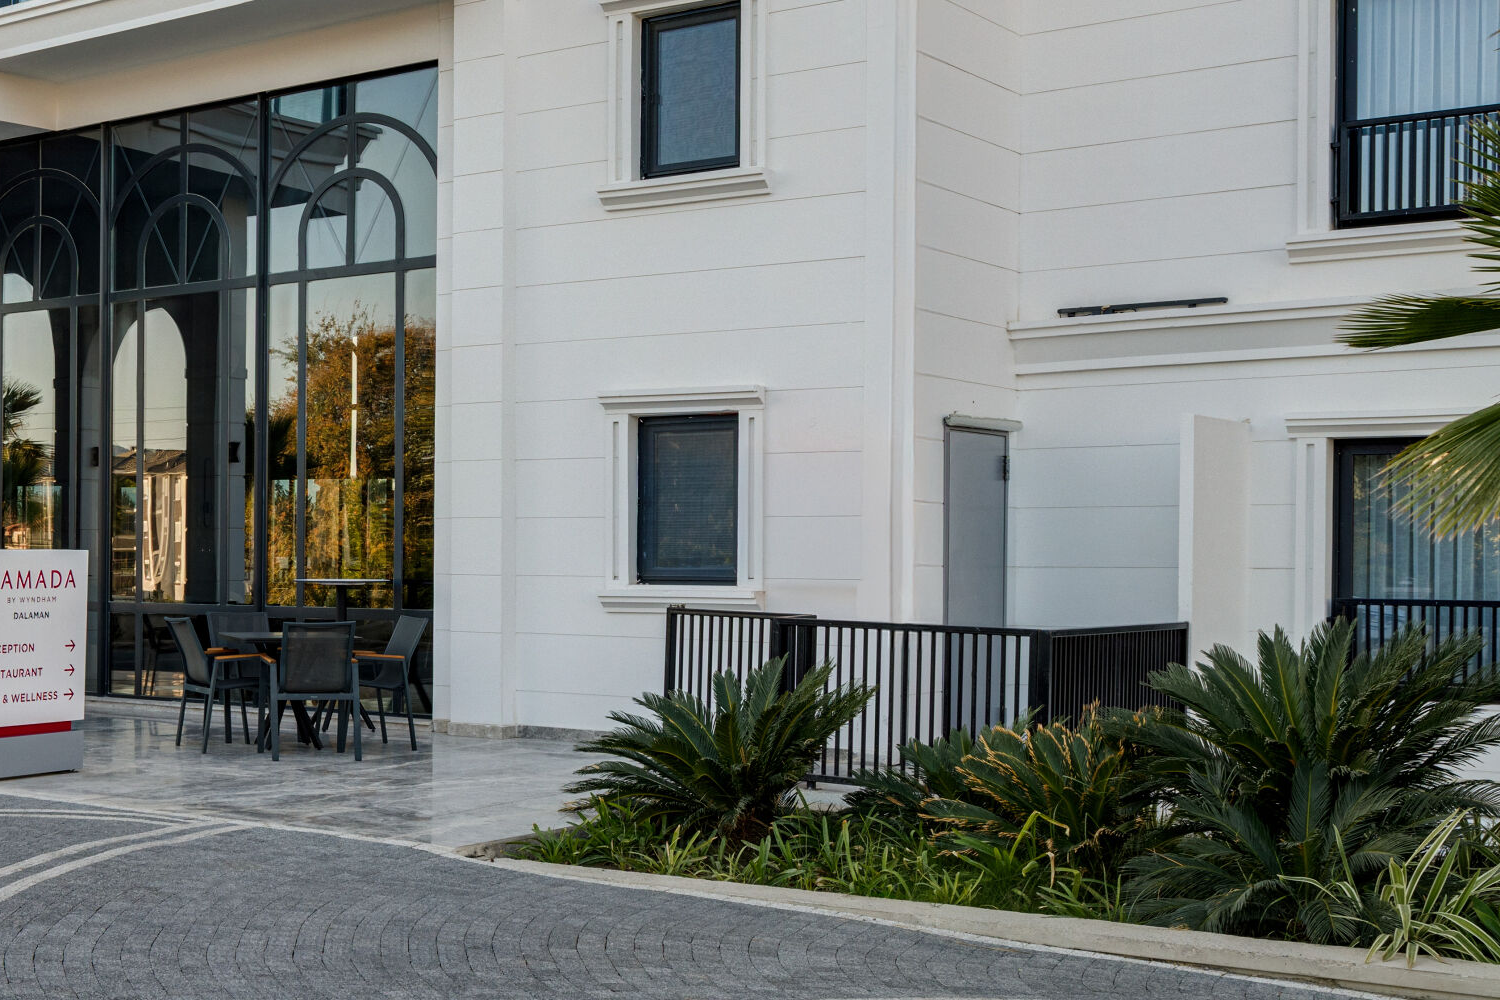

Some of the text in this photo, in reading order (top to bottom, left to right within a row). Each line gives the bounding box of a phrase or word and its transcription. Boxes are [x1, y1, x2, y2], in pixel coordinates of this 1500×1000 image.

[13, 611, 50, 620] DALAMAN
[2, 694, 9, 704] &
[11, 690, 59, 703] WELLNESS
